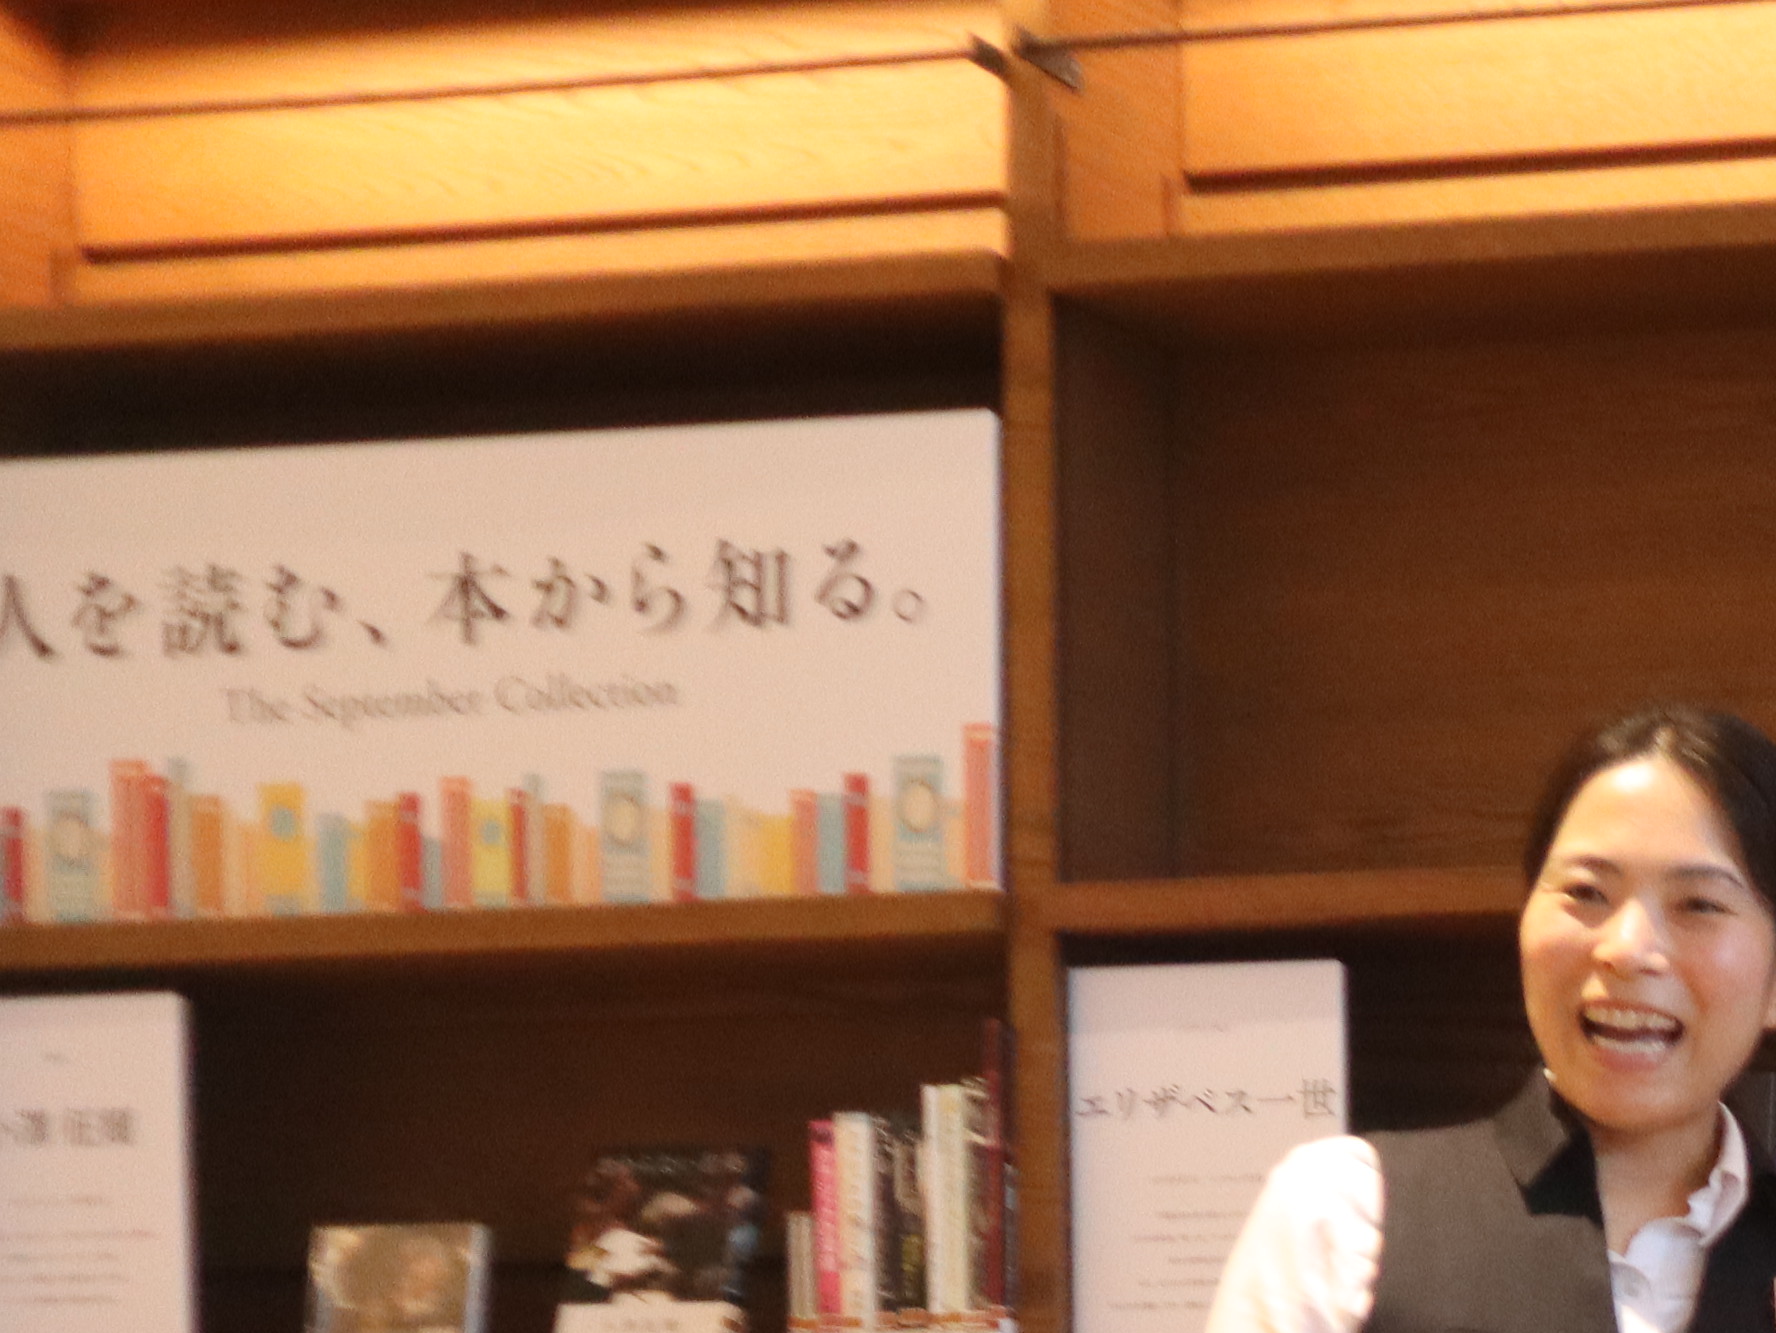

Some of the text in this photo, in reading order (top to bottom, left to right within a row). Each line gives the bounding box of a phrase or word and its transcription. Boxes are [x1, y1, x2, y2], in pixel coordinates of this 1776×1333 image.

[223, 672, 681, 731] The September Collection
